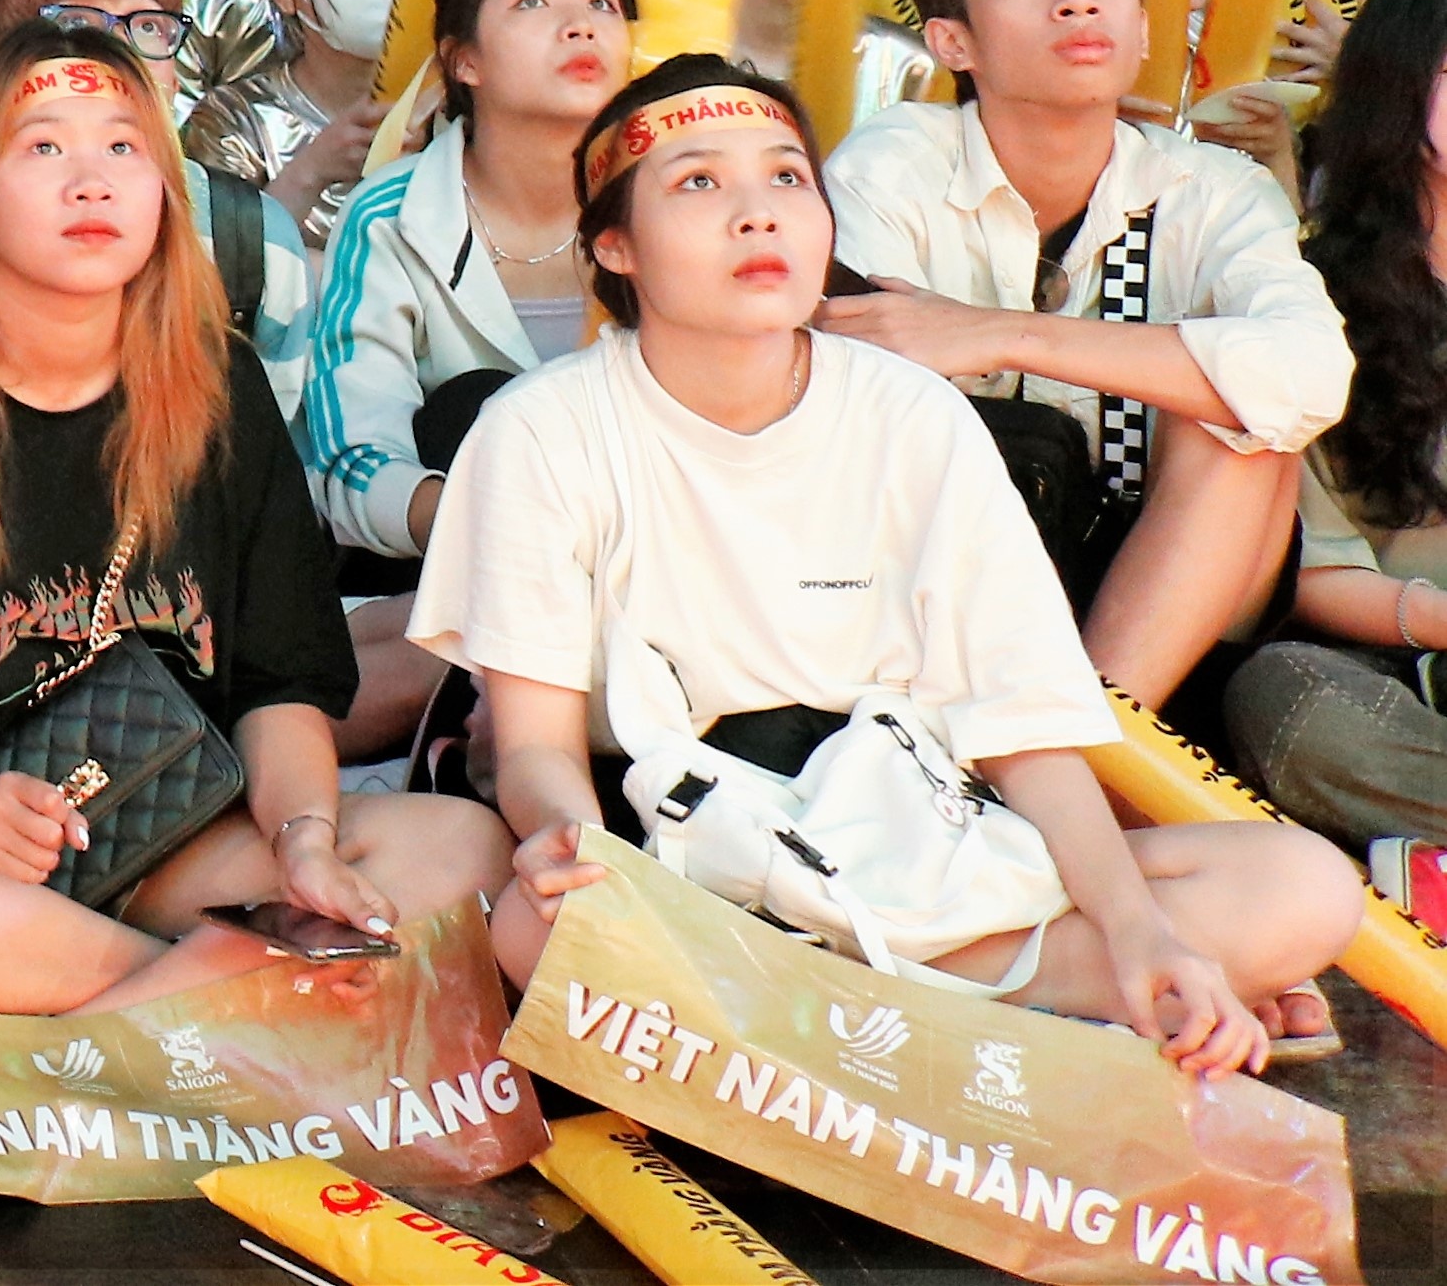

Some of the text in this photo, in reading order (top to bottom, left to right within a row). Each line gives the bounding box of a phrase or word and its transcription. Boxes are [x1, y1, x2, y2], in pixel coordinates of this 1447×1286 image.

[658, 97, 755, 130] THẮNG
[165, 1071, 229, 1091] SAIGON
[127, 1111, 344, 1165] THẮNG
[345, 1060, 521, 1153] VÀNG
[962, 1084, 1034, 1119] SAIGON
[565, 980, 715, 1084] VIỆT
[714, 1052, 879, 1160] NAM
[890, 1113, 1122, 1247] THẮNG
[1131, 1202, 1329, 1286] VÀNG
